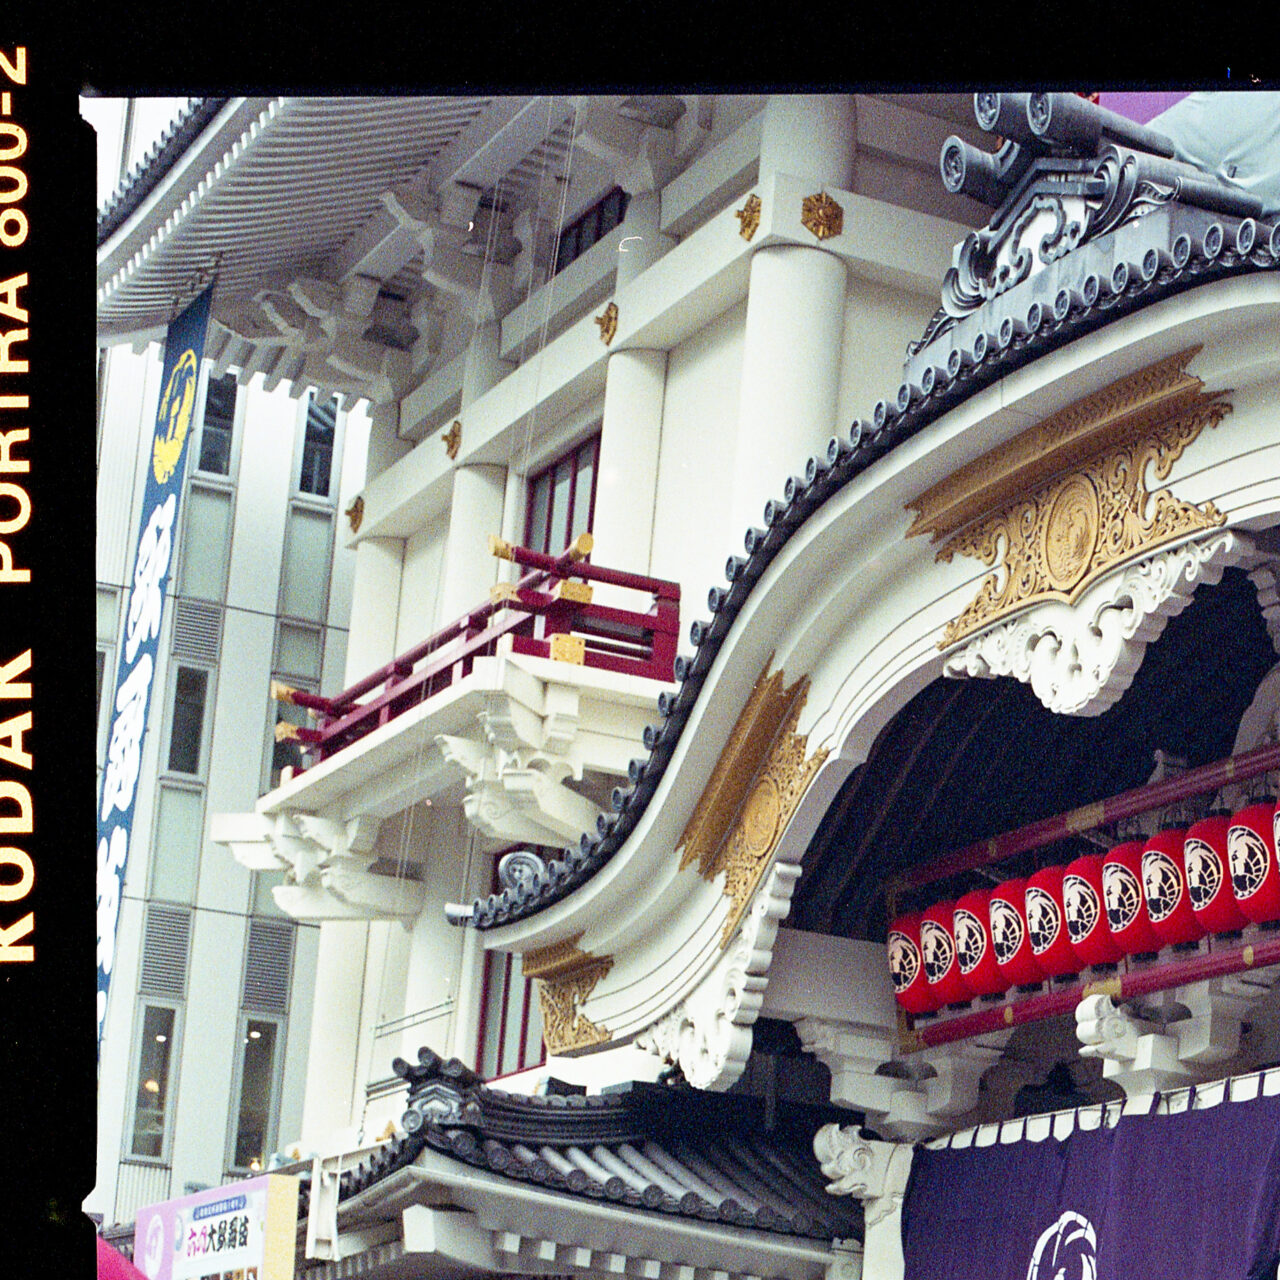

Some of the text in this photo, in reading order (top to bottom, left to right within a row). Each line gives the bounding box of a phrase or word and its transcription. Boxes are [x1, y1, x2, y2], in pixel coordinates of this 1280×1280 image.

[0, 272, 32, 583] PORTRA
[0, 648, 35, 962] KODAK
[97, 493, 176, 1024] 歌舞伎
[187, 1215, 249, 1257] 六月大歌舞伎
